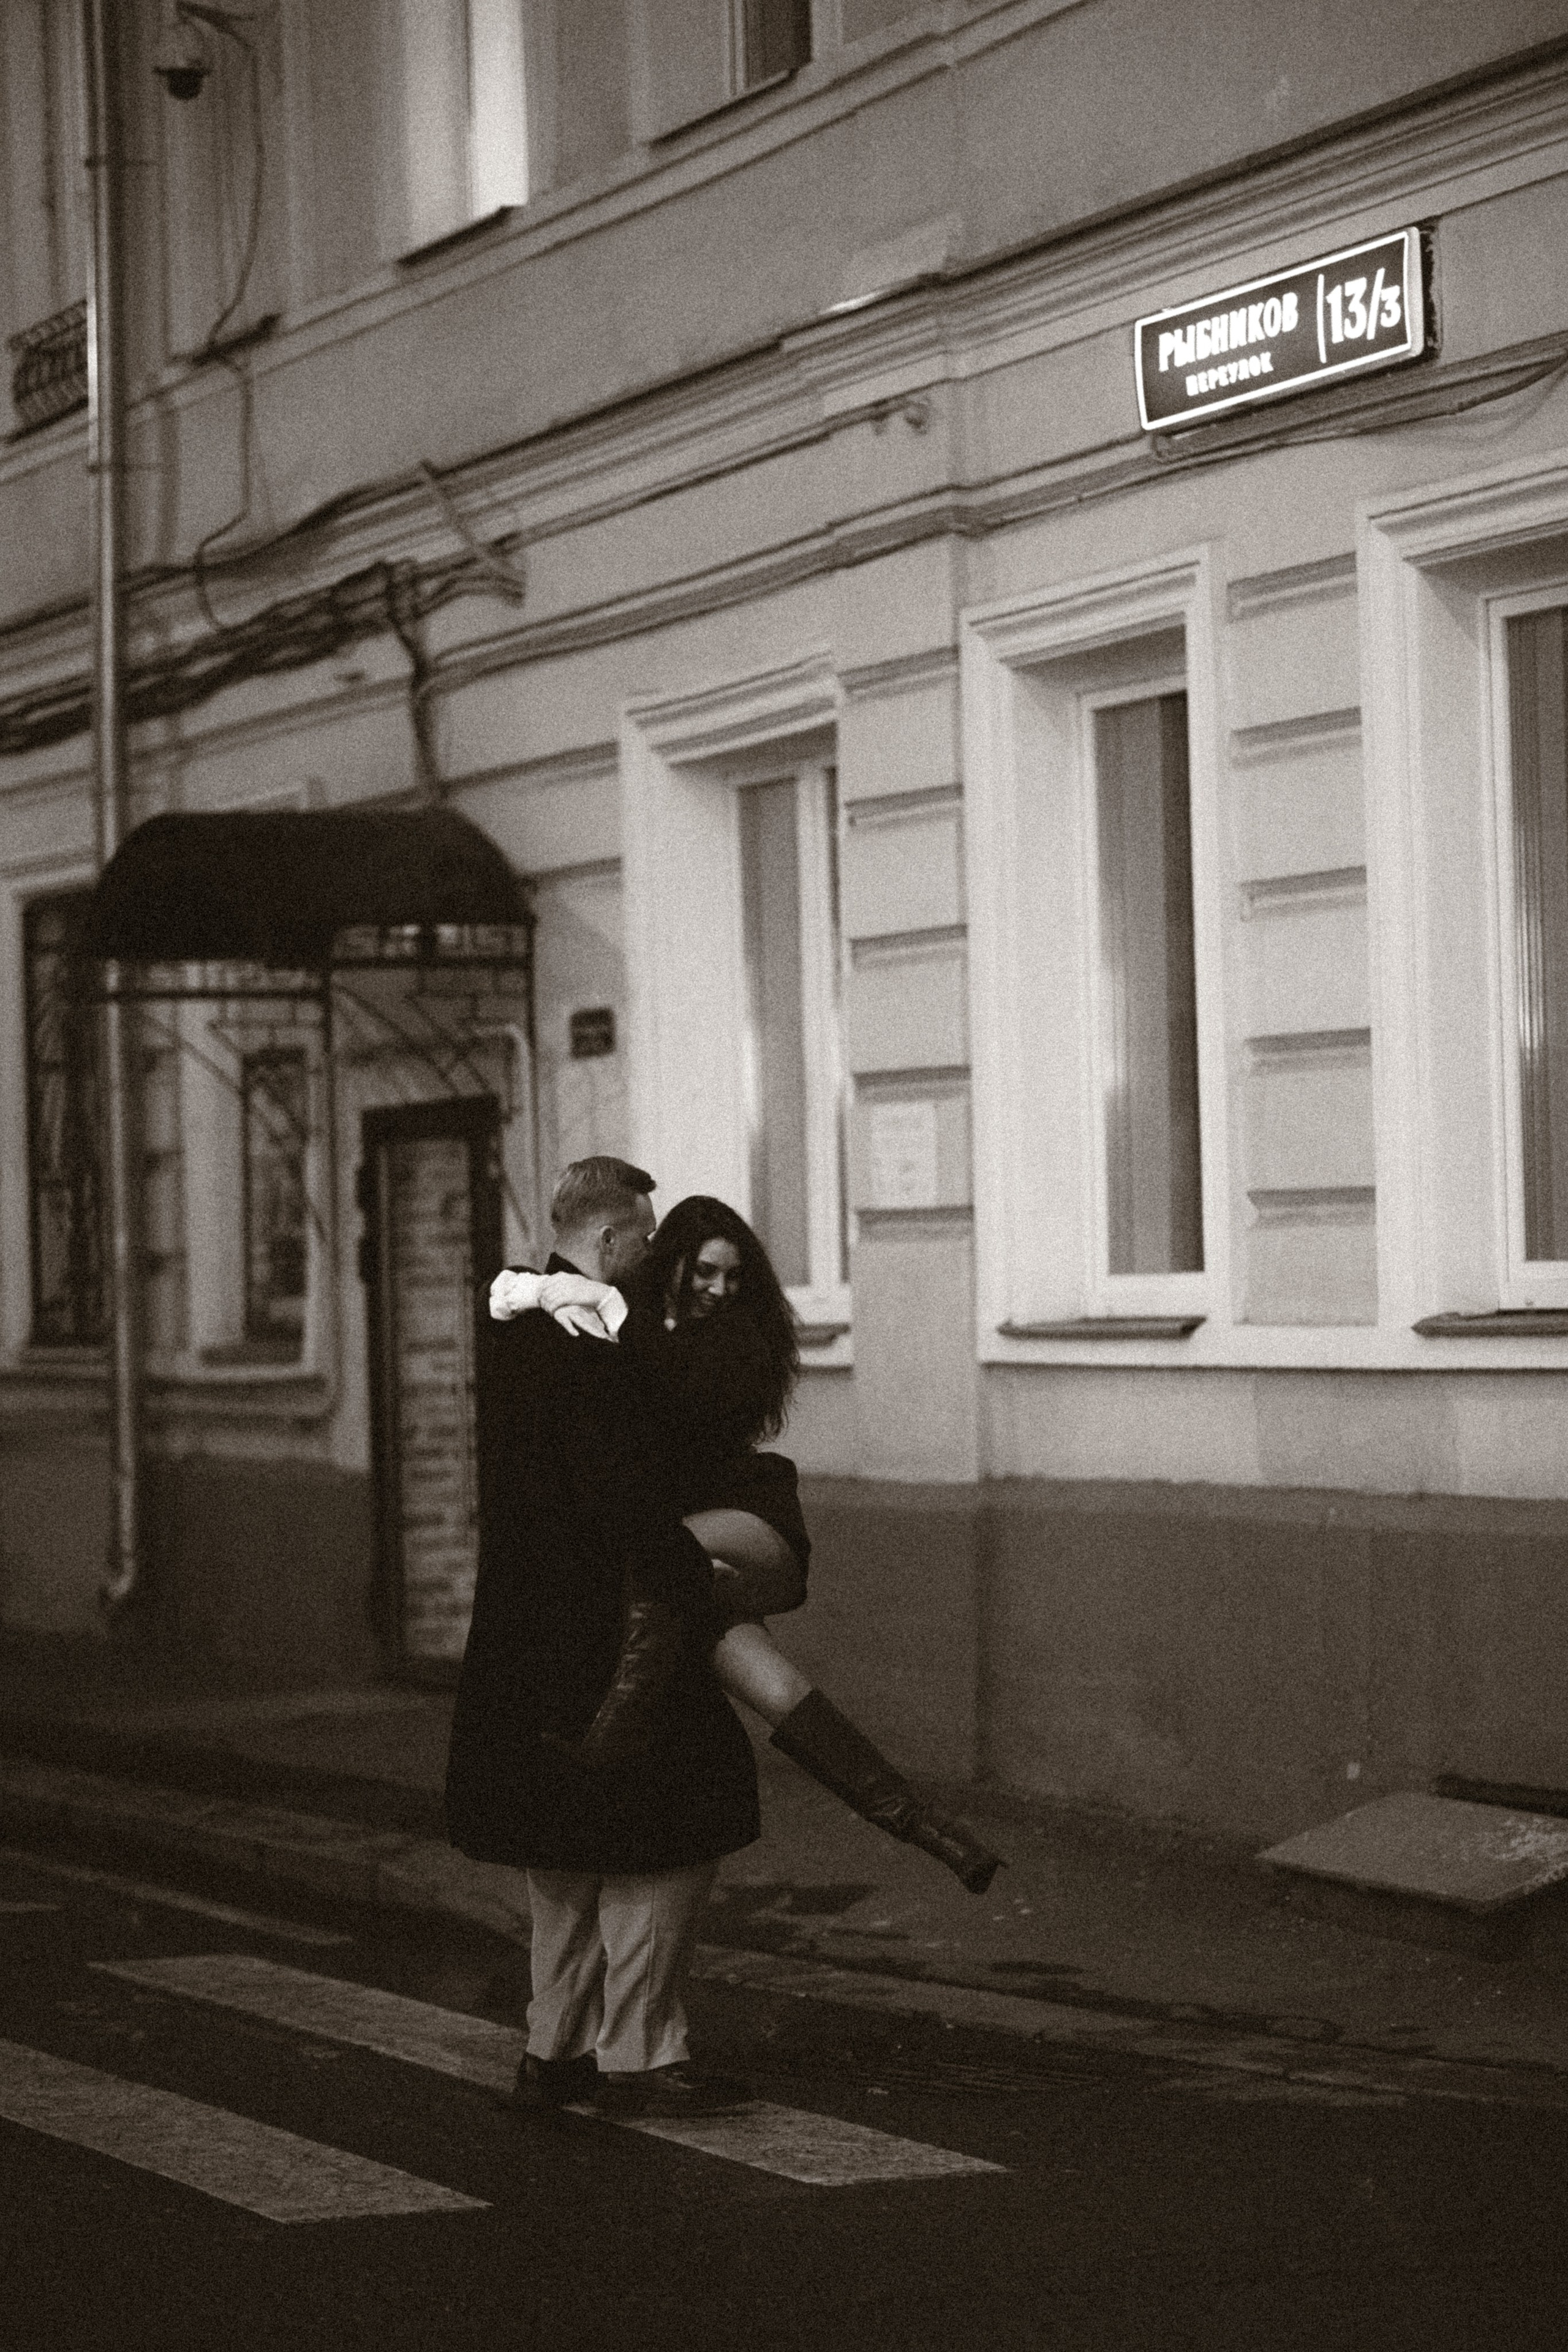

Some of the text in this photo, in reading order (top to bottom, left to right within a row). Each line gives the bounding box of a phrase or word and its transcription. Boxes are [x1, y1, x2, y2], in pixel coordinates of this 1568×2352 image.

[1159, 292, 1298, 372] РЫБНИКОВ
[1325, 268, 1401, 344] 13/3
[1186, 352, 1273, 396] ПЕРЕУЛОК
